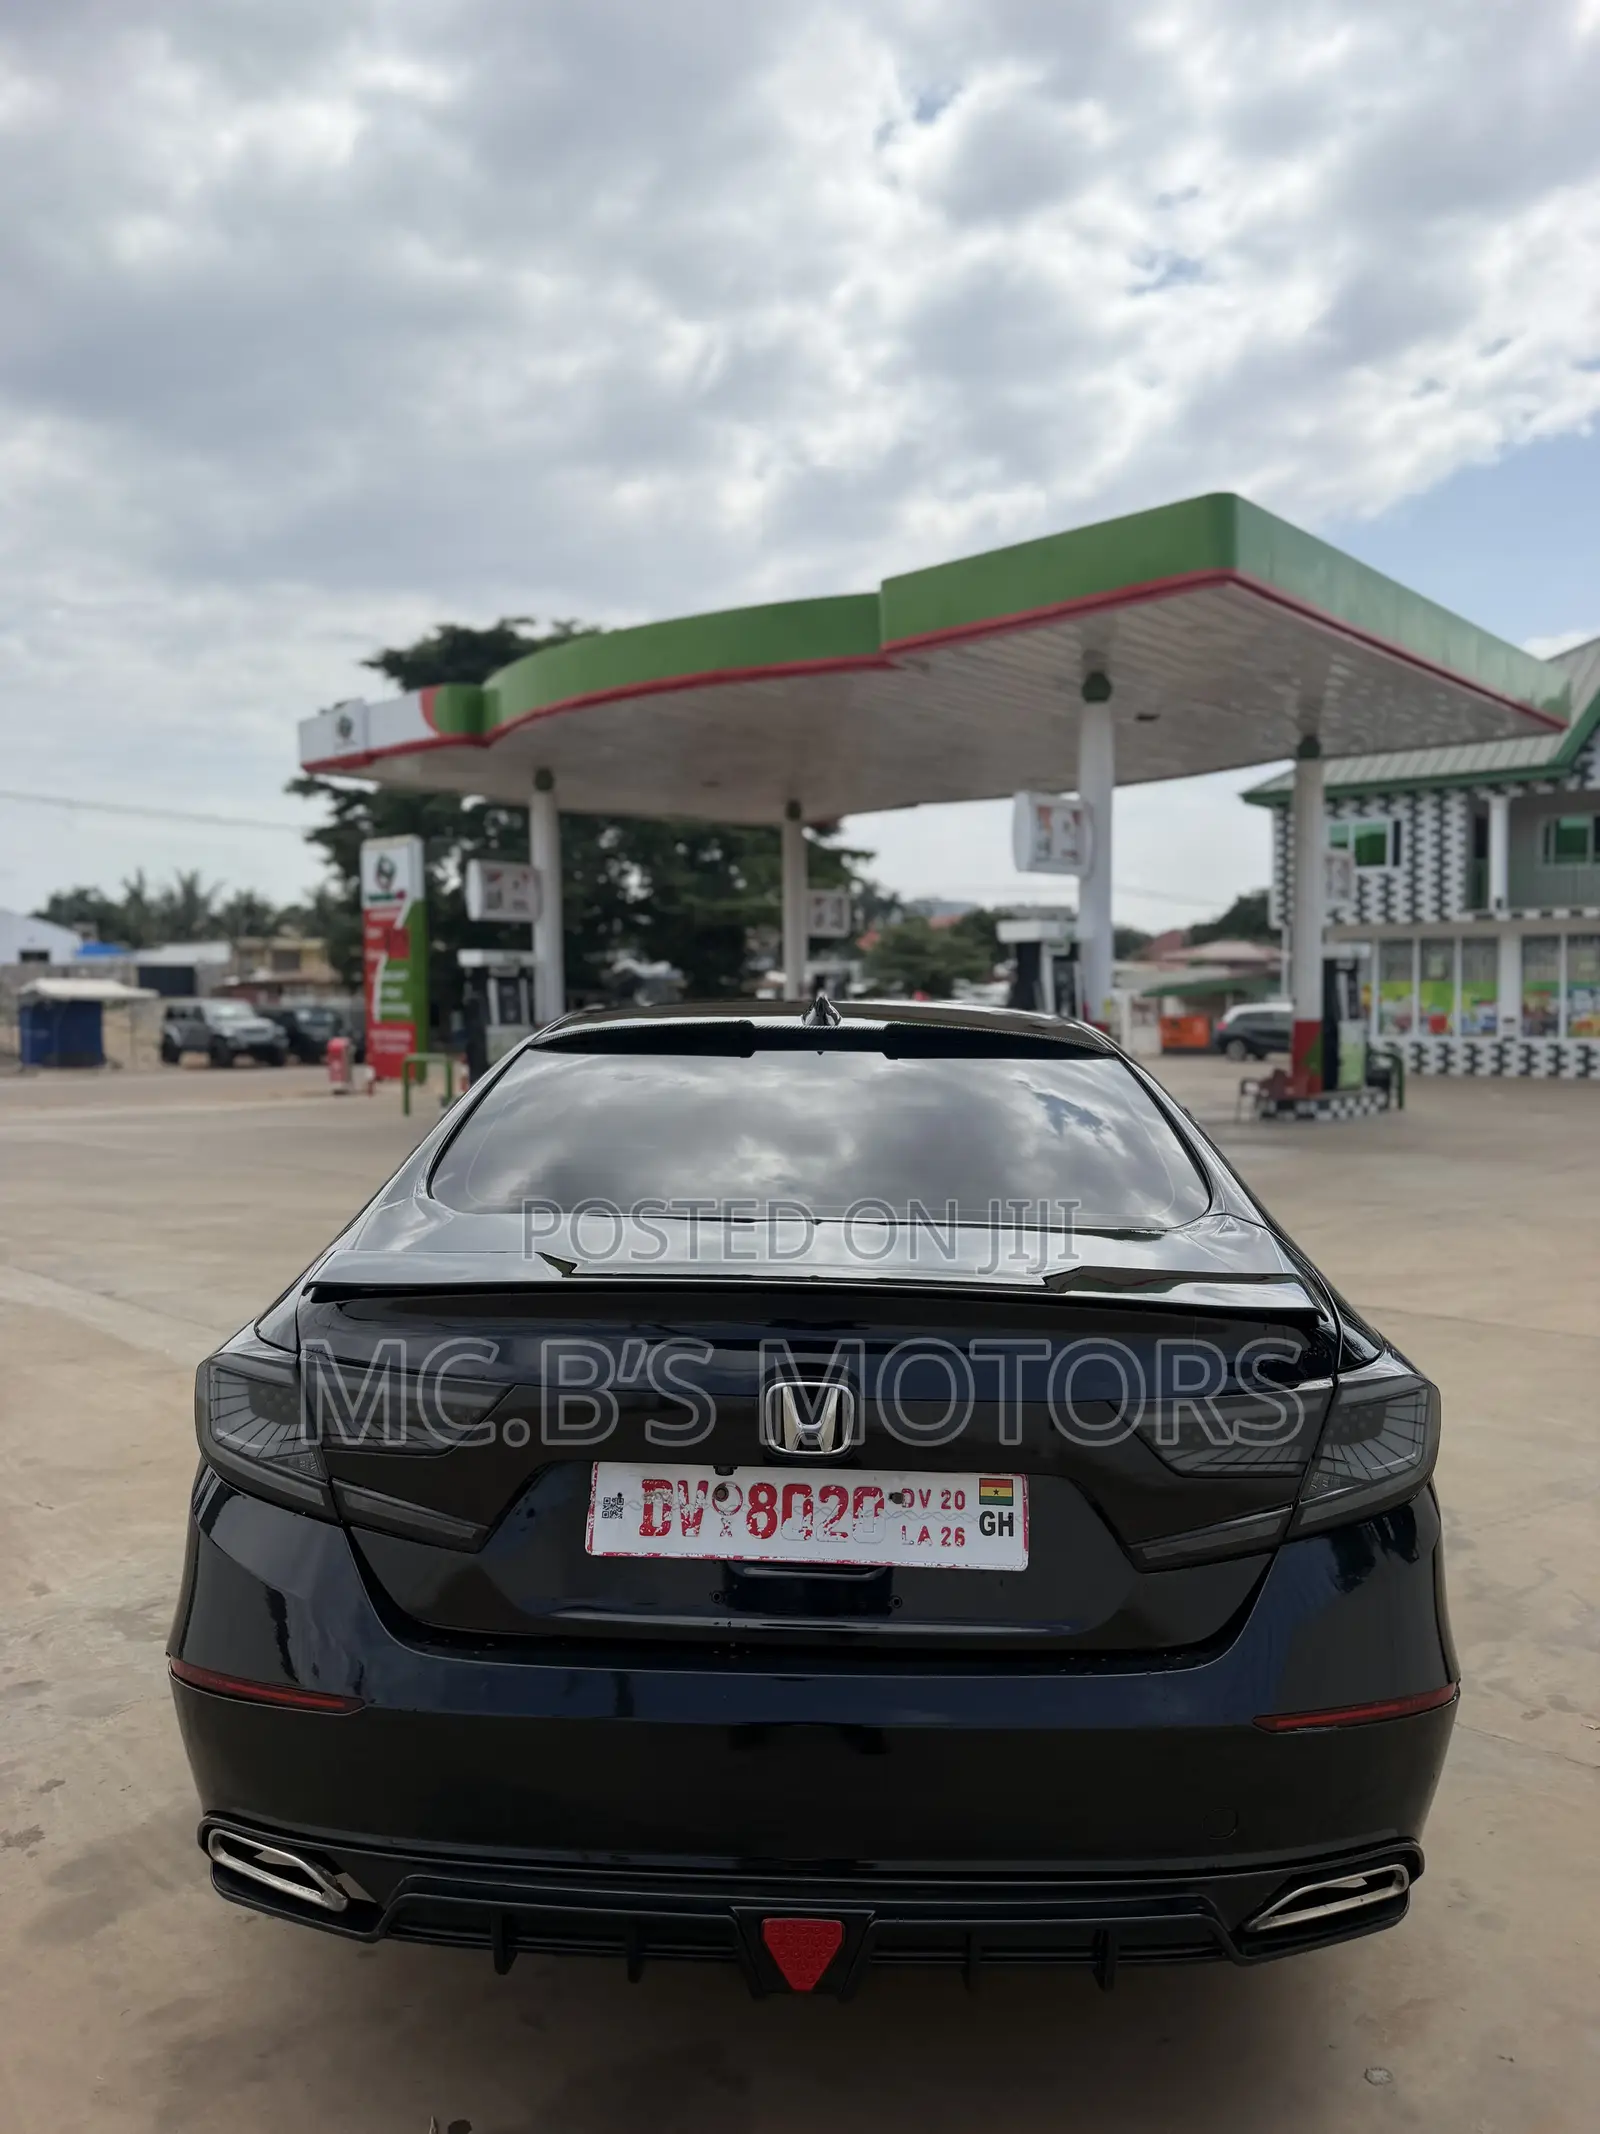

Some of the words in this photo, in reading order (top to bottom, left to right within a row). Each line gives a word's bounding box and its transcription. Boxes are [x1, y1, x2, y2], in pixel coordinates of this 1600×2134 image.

[639, 1479, 709, 1537] DV
[746, 1482, 886, 1543] 8020
[901, 1488, 932, 1508] DV
[941, 1489, 966, 1510] 20
[901, 1525, 933, 1546] LA
[941, 1526, 966, 1547] 26
[979, 1511, 1014, 1537] GH
